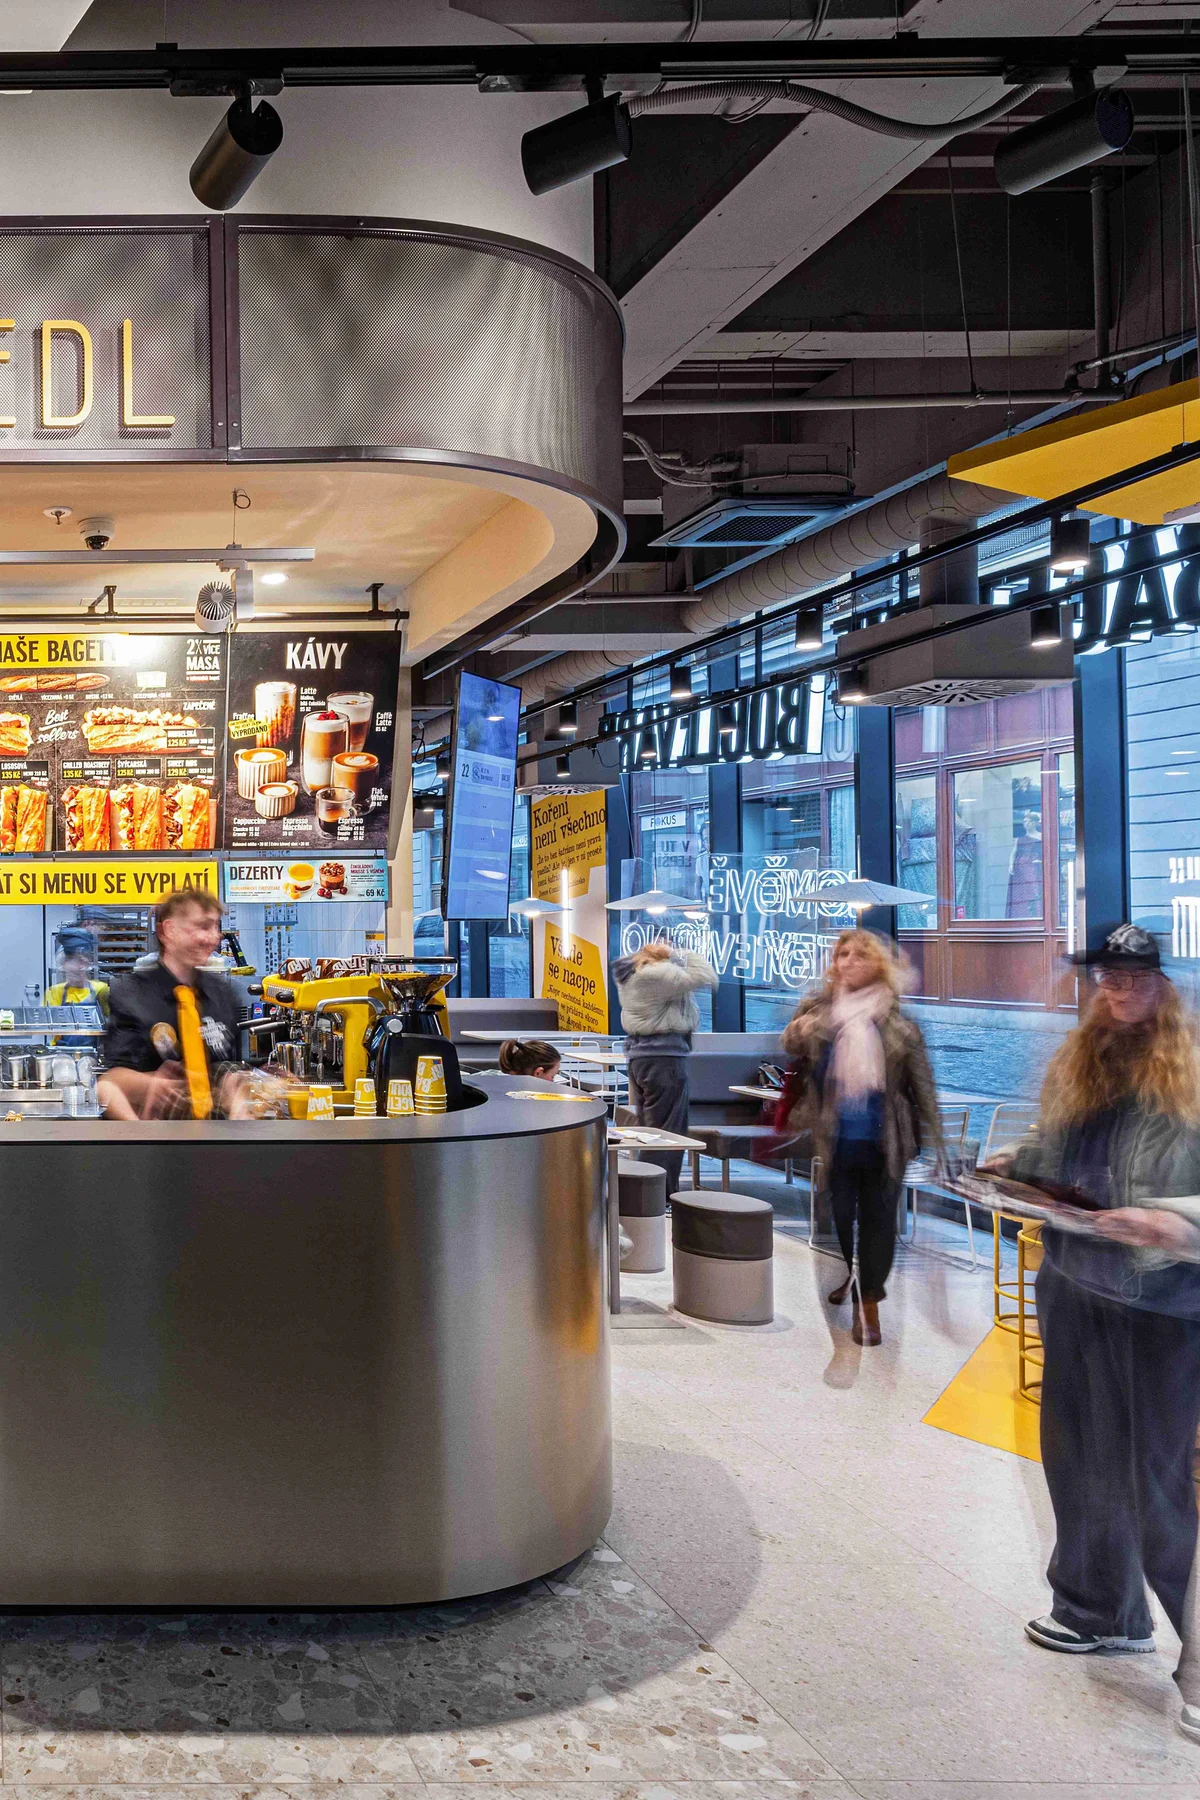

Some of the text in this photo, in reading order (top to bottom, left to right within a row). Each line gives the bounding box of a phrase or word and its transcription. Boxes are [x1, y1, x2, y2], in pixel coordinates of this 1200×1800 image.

[47, 639, 116, 662] BAGET
[286, 637, 348, 669] KÁVY
[186, 656, 221, 670] MASA
[300, 687, 317, 695] Latte
[45, 709, 69, 725] Best
[36, 728, 80, 745] sellers
[167, 739, 178, 747] 125
[461, 763, 470, 778] 22
[533, 795, 569, 829] Koření
[535, 808, 606, 850] není všechno
[19, 873, 37, 894] SI
[43, 873, 97, 894] MENU
[104, 873, 127, 894] SE
[133, 868, 210, 894] VYPLATÍ
[229, 866, 284, 880] DEZERTY
[365, 888, 385, 897] 69 Kč
[548, 962, 596, 996] se nacpe
